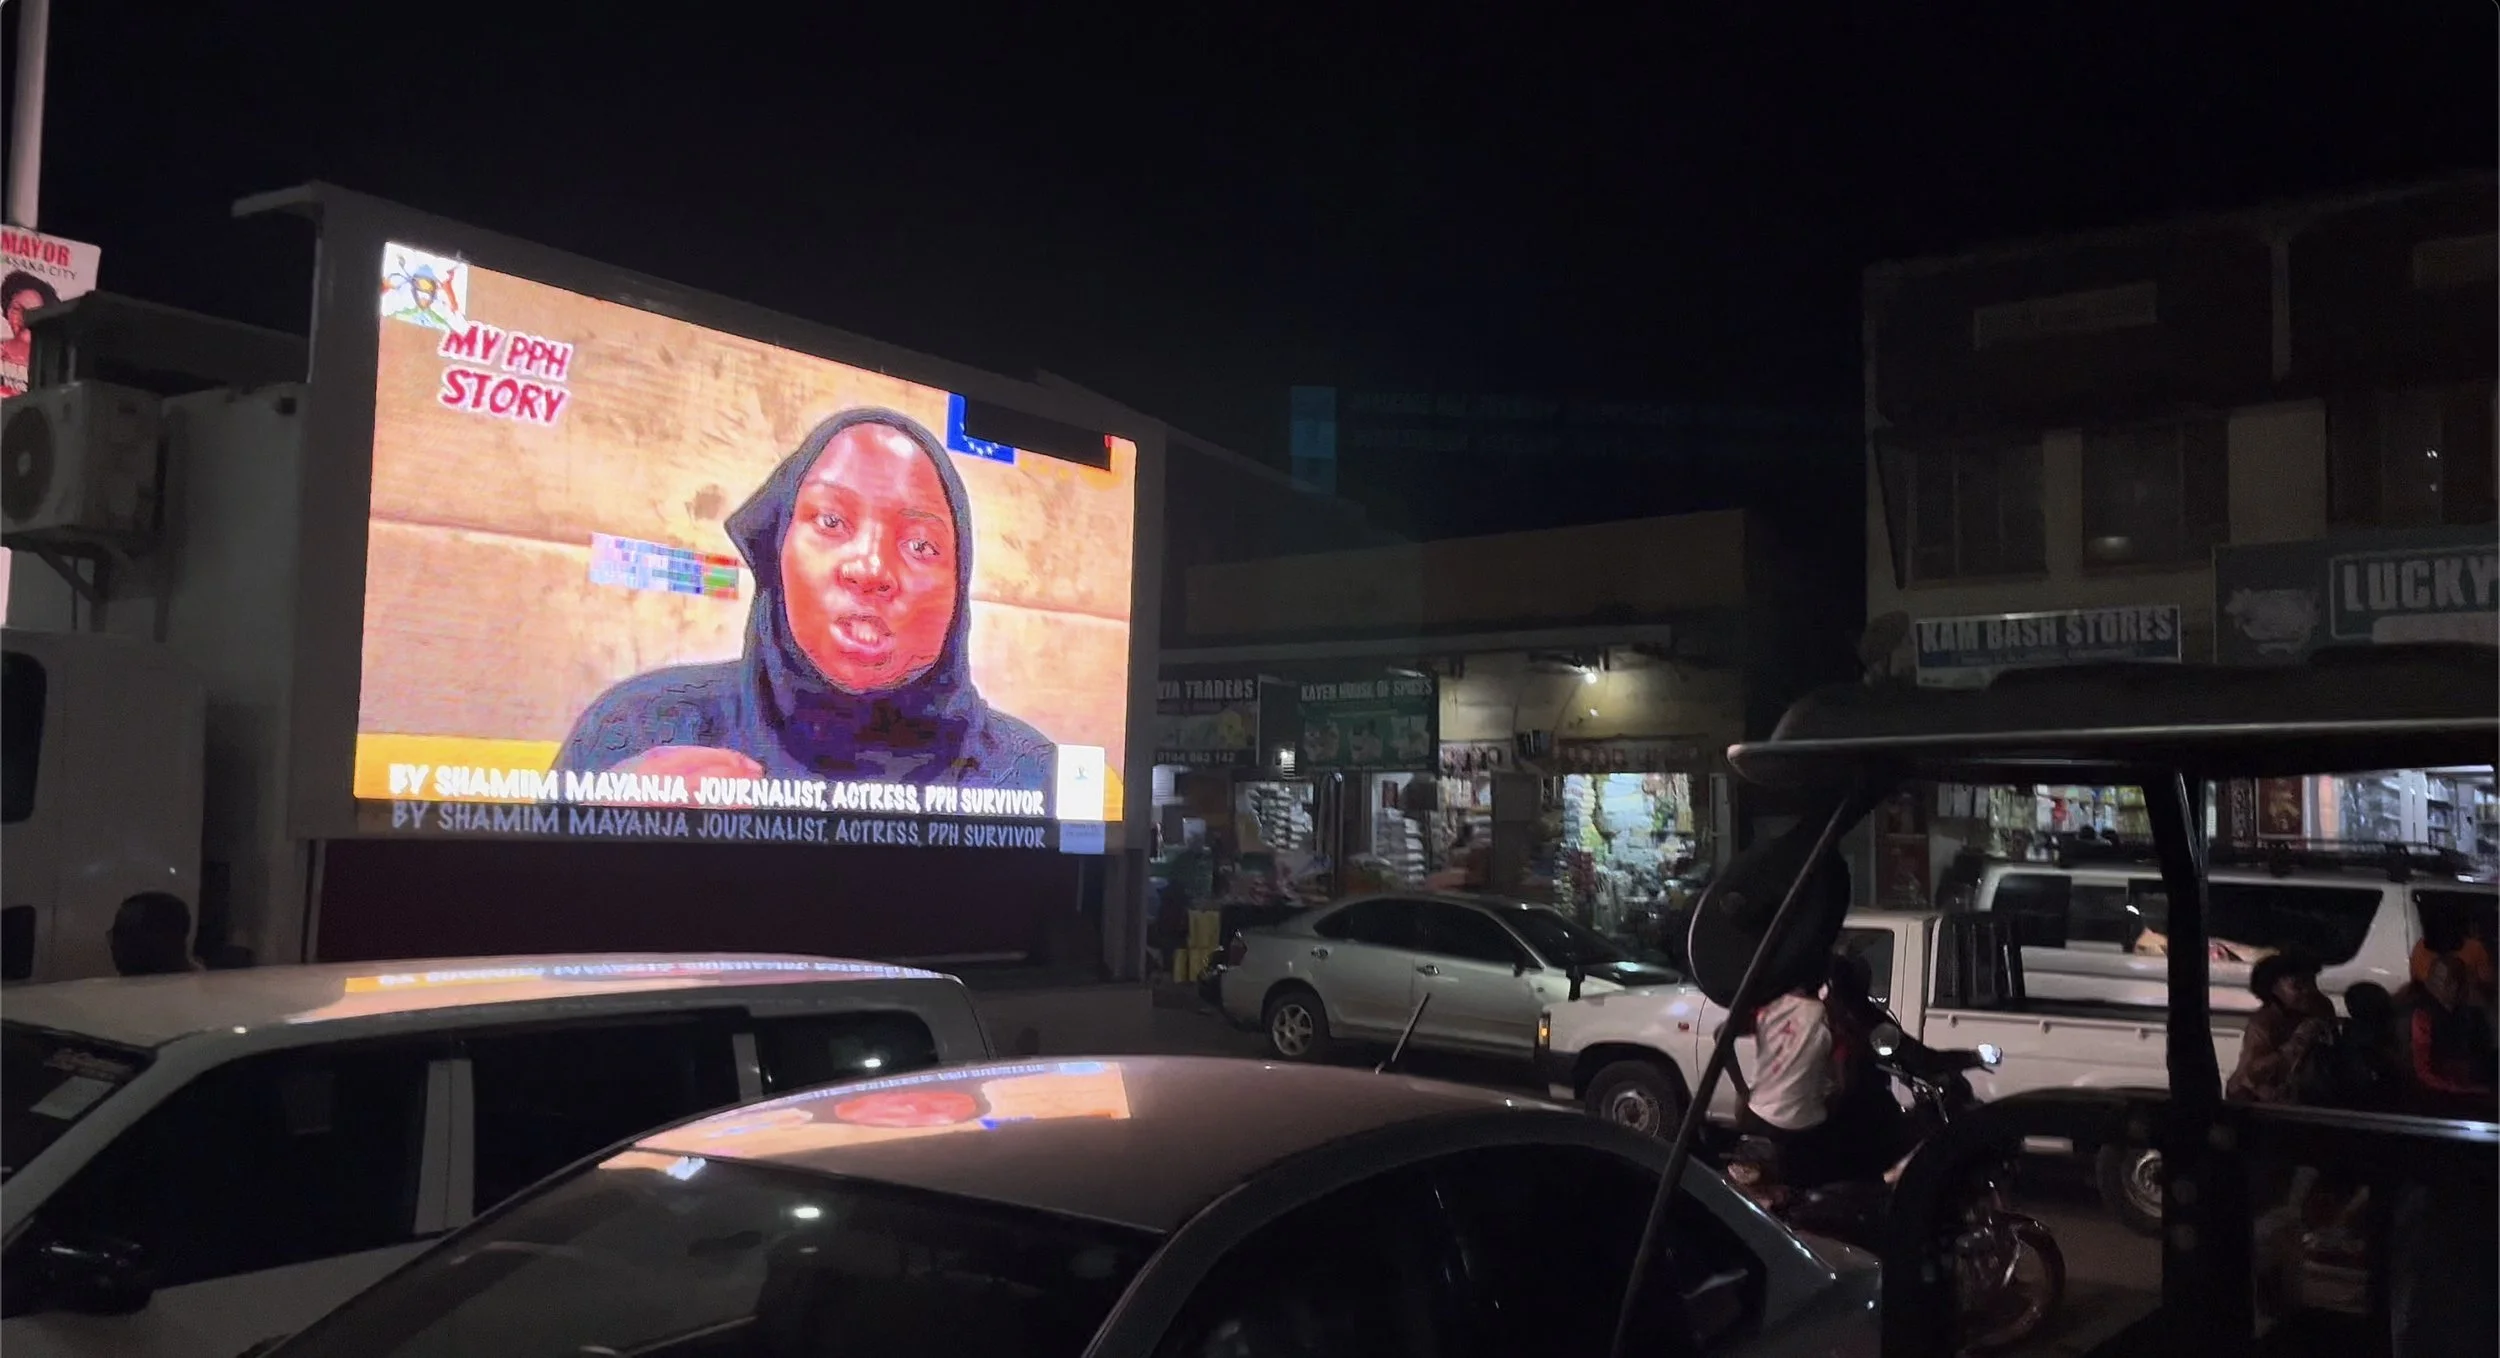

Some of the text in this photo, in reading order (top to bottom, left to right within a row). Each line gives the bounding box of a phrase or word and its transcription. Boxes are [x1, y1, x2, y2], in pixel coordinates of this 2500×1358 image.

[2, 231, 71, 266] MAYOR
[49, 266, 77, 280] CITY
[440, 323, 571, 379] MY PPH
[440, 368, 568, 424] STORY
[2343, 555, 2497, 611] LUCKY
[1987, 617, 2057, 648] BASH
[2065, 608, 2174, 645] STORES
[1184, 678, 1254, 700] TRADERS
[1339, 681, 1375, 698] HOUSE
[1377, 679, 1390, 698] OF
[389, 764, 1045, 816] BY SHAMIM MAYANJA JOURNALIST, ACTRESS, PPH SURVIVOR
[391, 800, 430, 829] BY
[437, 803, 560, 834] SHAMIM
[568, 808, 690, 837] MAYANJA
[928, 822, 959, 847] PPH
[964, 823, 1046, 849] SURVIVOR
